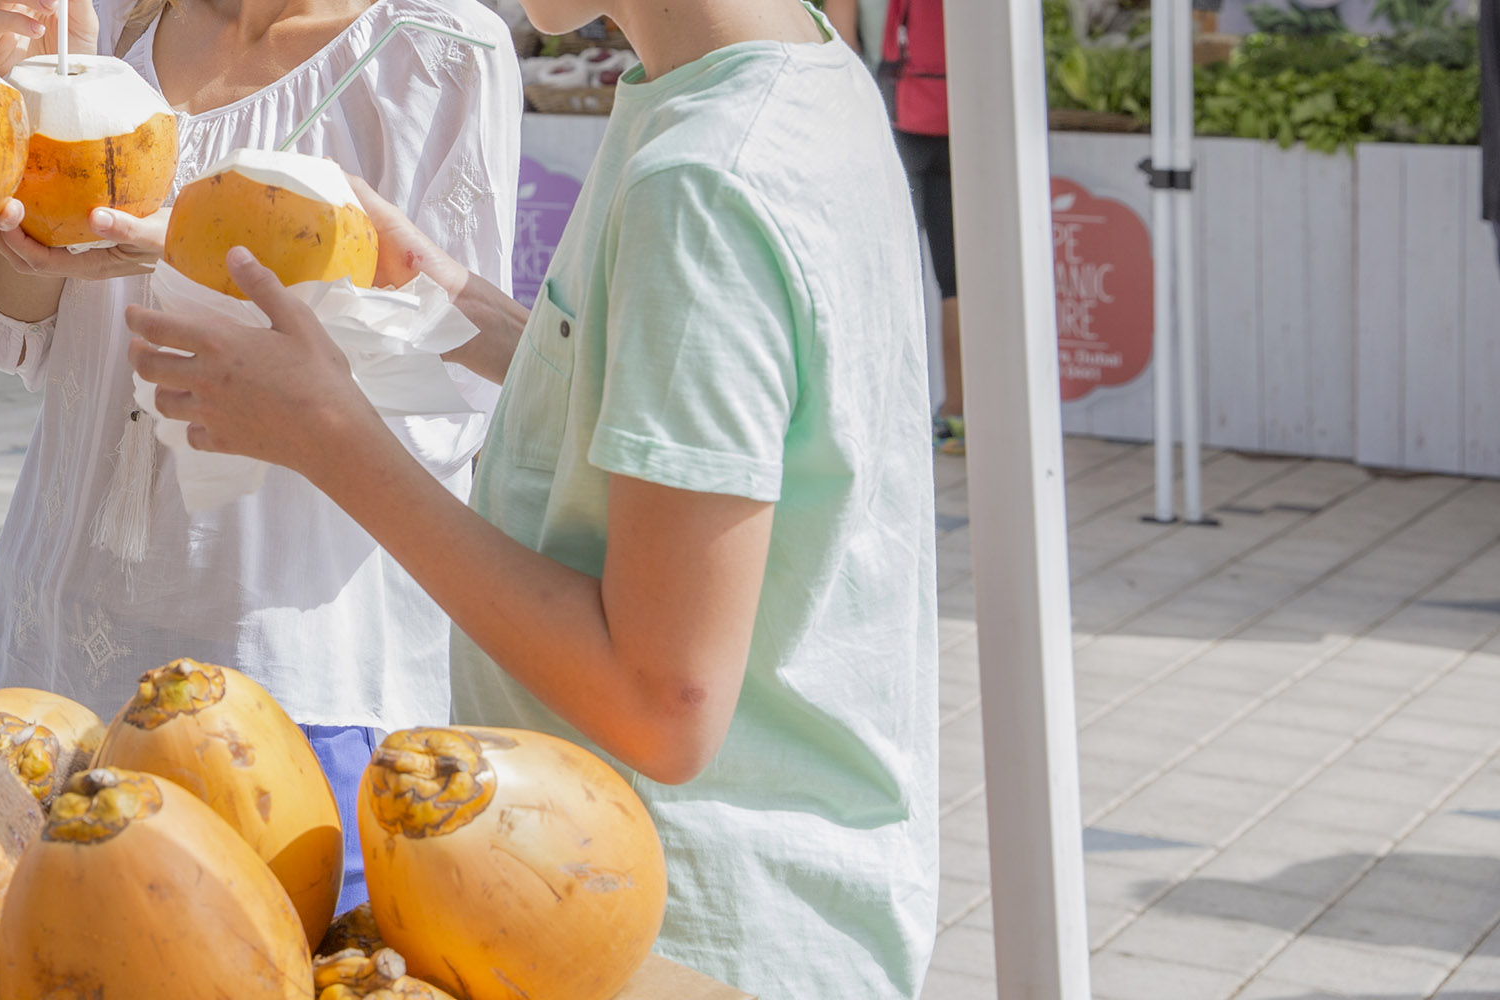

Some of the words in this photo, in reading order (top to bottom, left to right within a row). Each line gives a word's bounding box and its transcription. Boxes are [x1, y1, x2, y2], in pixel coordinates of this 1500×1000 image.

[515, 209, 543, 247] PE
[1052, 222, 1083, 264] PE
[1054, 263, 1116, 303] ANIC
